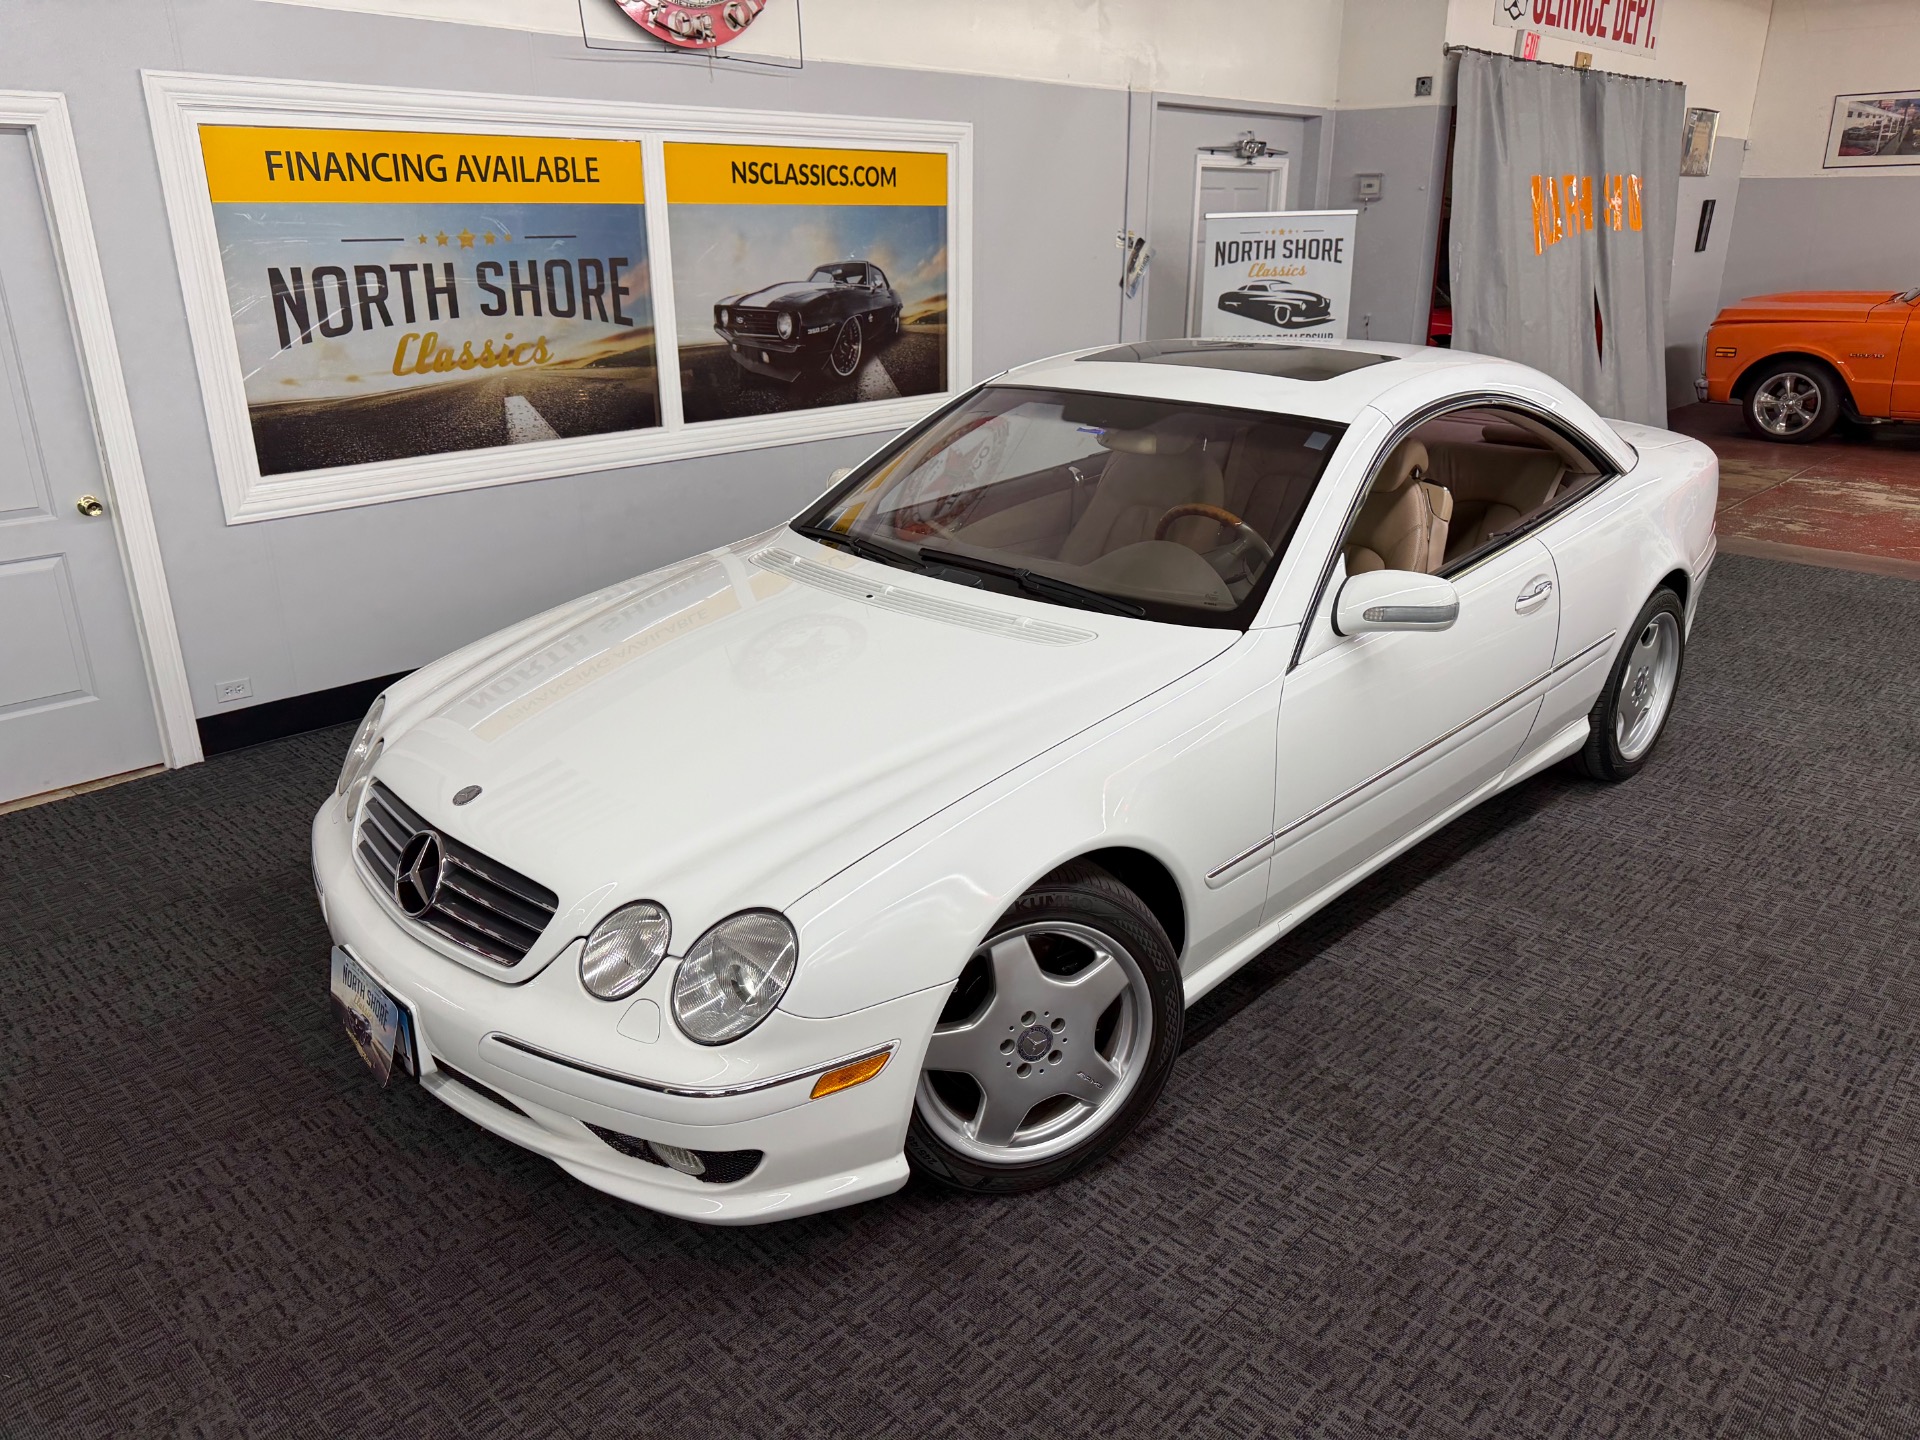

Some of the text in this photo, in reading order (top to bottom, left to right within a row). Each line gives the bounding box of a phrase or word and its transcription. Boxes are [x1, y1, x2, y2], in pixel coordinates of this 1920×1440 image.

[1523, 32, 1541, 60] EXIT
[264, 150, 600, 184] FINANCING AVAILABLE
[731, 161, 897, 187] NSCLASSICS.COM
[1214, 238, 1344, 267] NORTH SHORE
[1248, 263, 1307, 278] Classics
[266, 257, 634, 350] NORTH SHORE
[391, 330, 554, 377] Classics
[1015, 894, 1093, 912] KUMHO
[342, 964, 366, 999] NORTH
[366, 989, 389, 1032] SHORE
